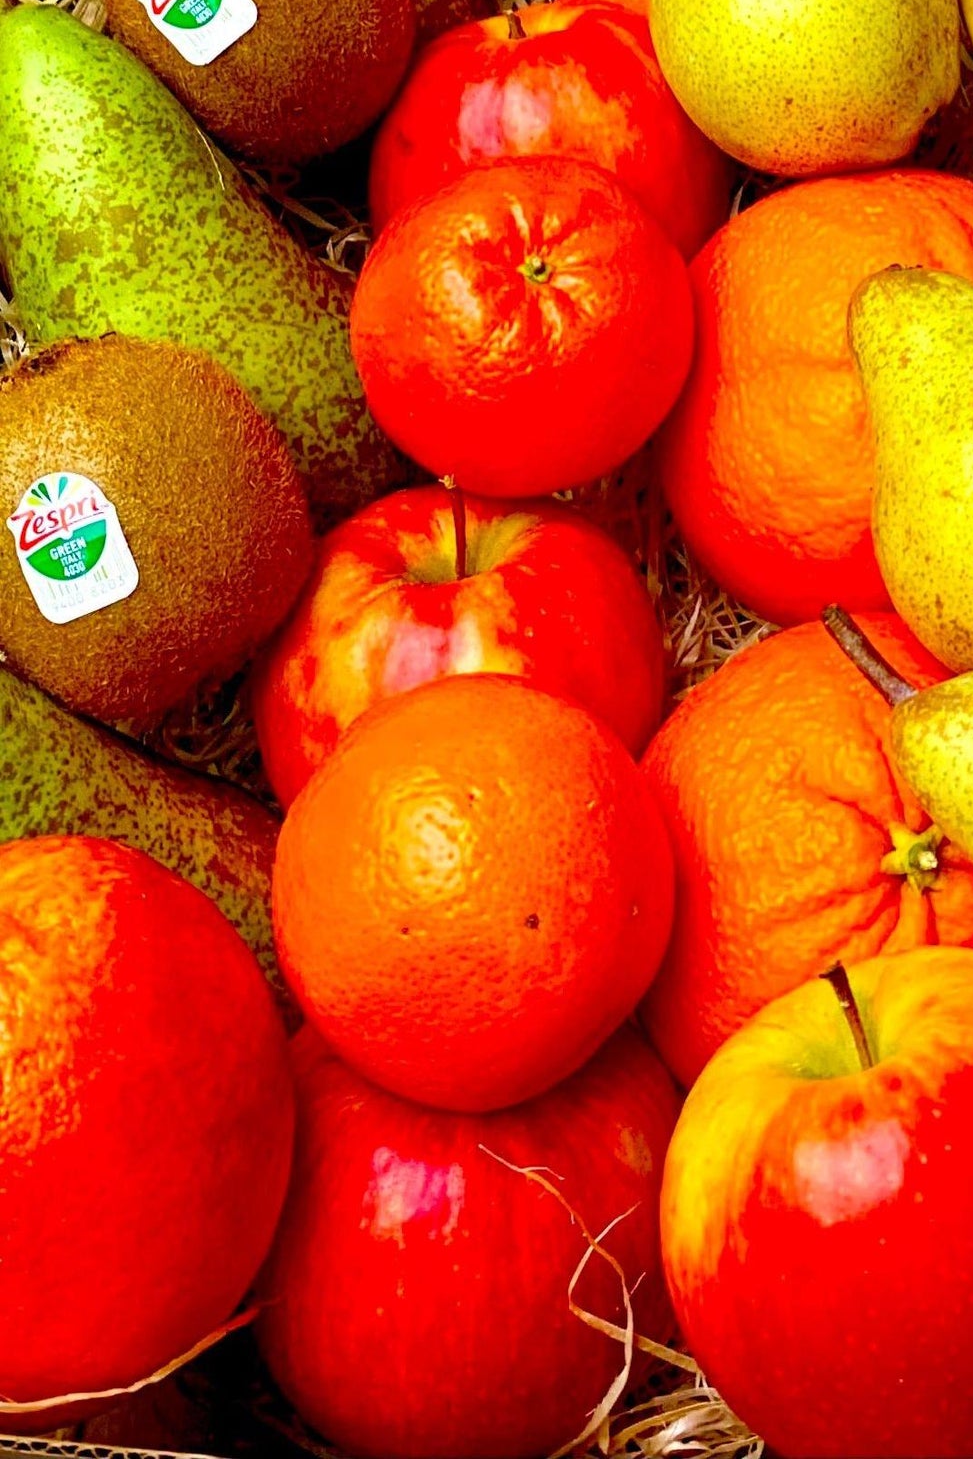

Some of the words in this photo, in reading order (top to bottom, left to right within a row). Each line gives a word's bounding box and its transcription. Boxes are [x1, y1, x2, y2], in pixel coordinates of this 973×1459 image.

[10, 489, 99, 552] Zespri
[50, 537, 88, 560] GREEN
[63, 561, 87, 578] 4030
